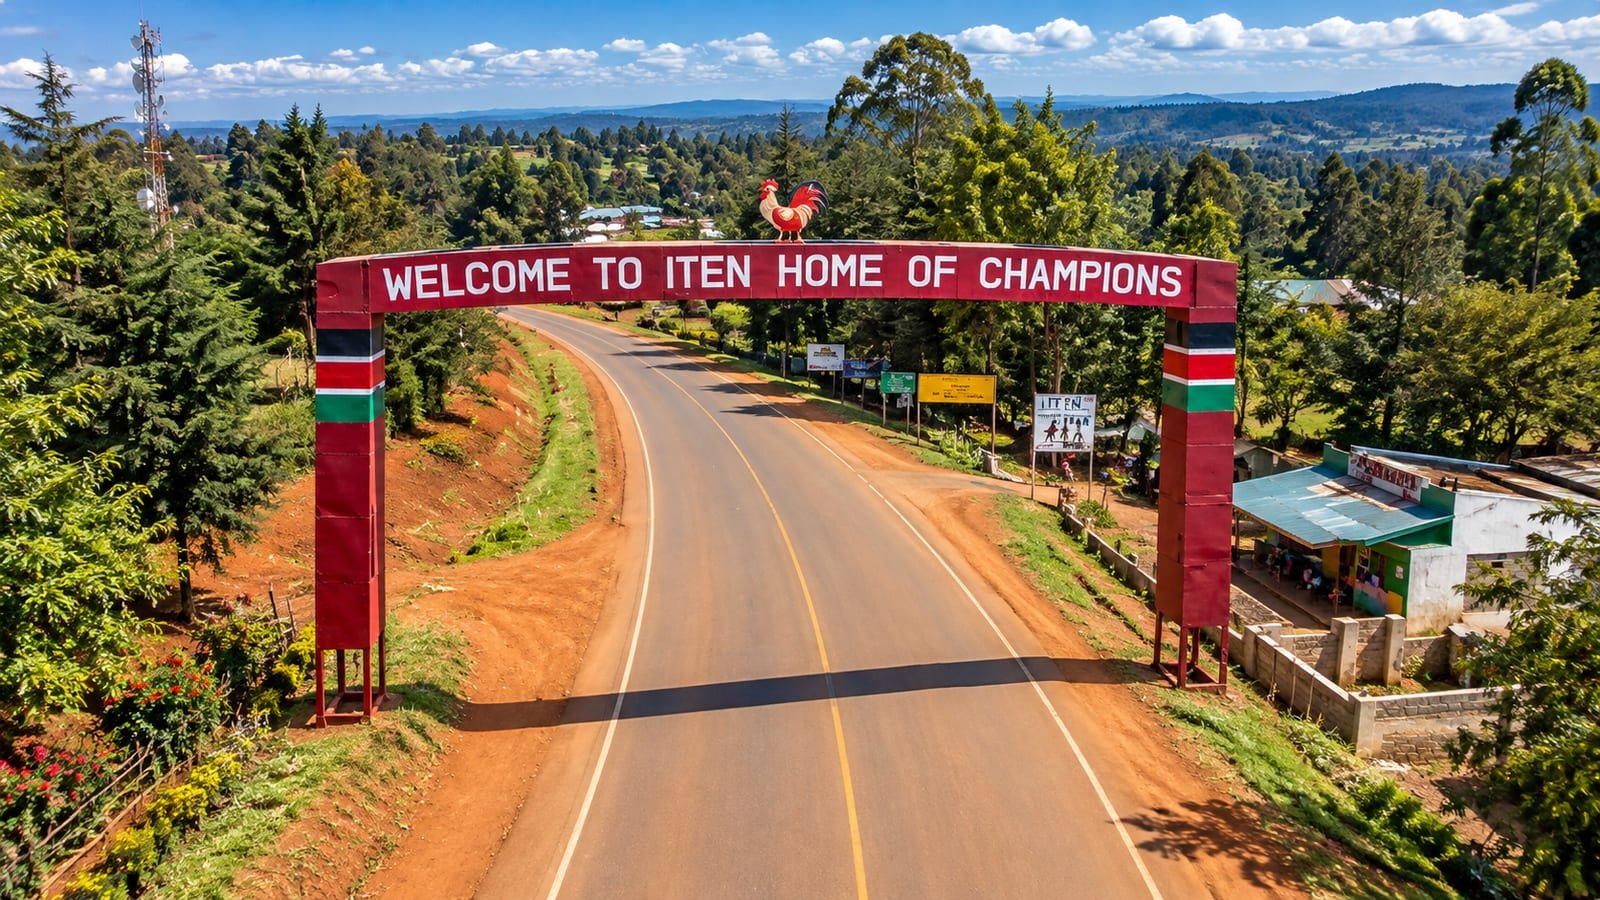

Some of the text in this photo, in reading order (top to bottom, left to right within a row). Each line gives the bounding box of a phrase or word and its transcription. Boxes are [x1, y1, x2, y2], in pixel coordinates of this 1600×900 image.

[382, 253, 1182, 301] WELCOME TO ITEN HOME OF CHAMPIONS
